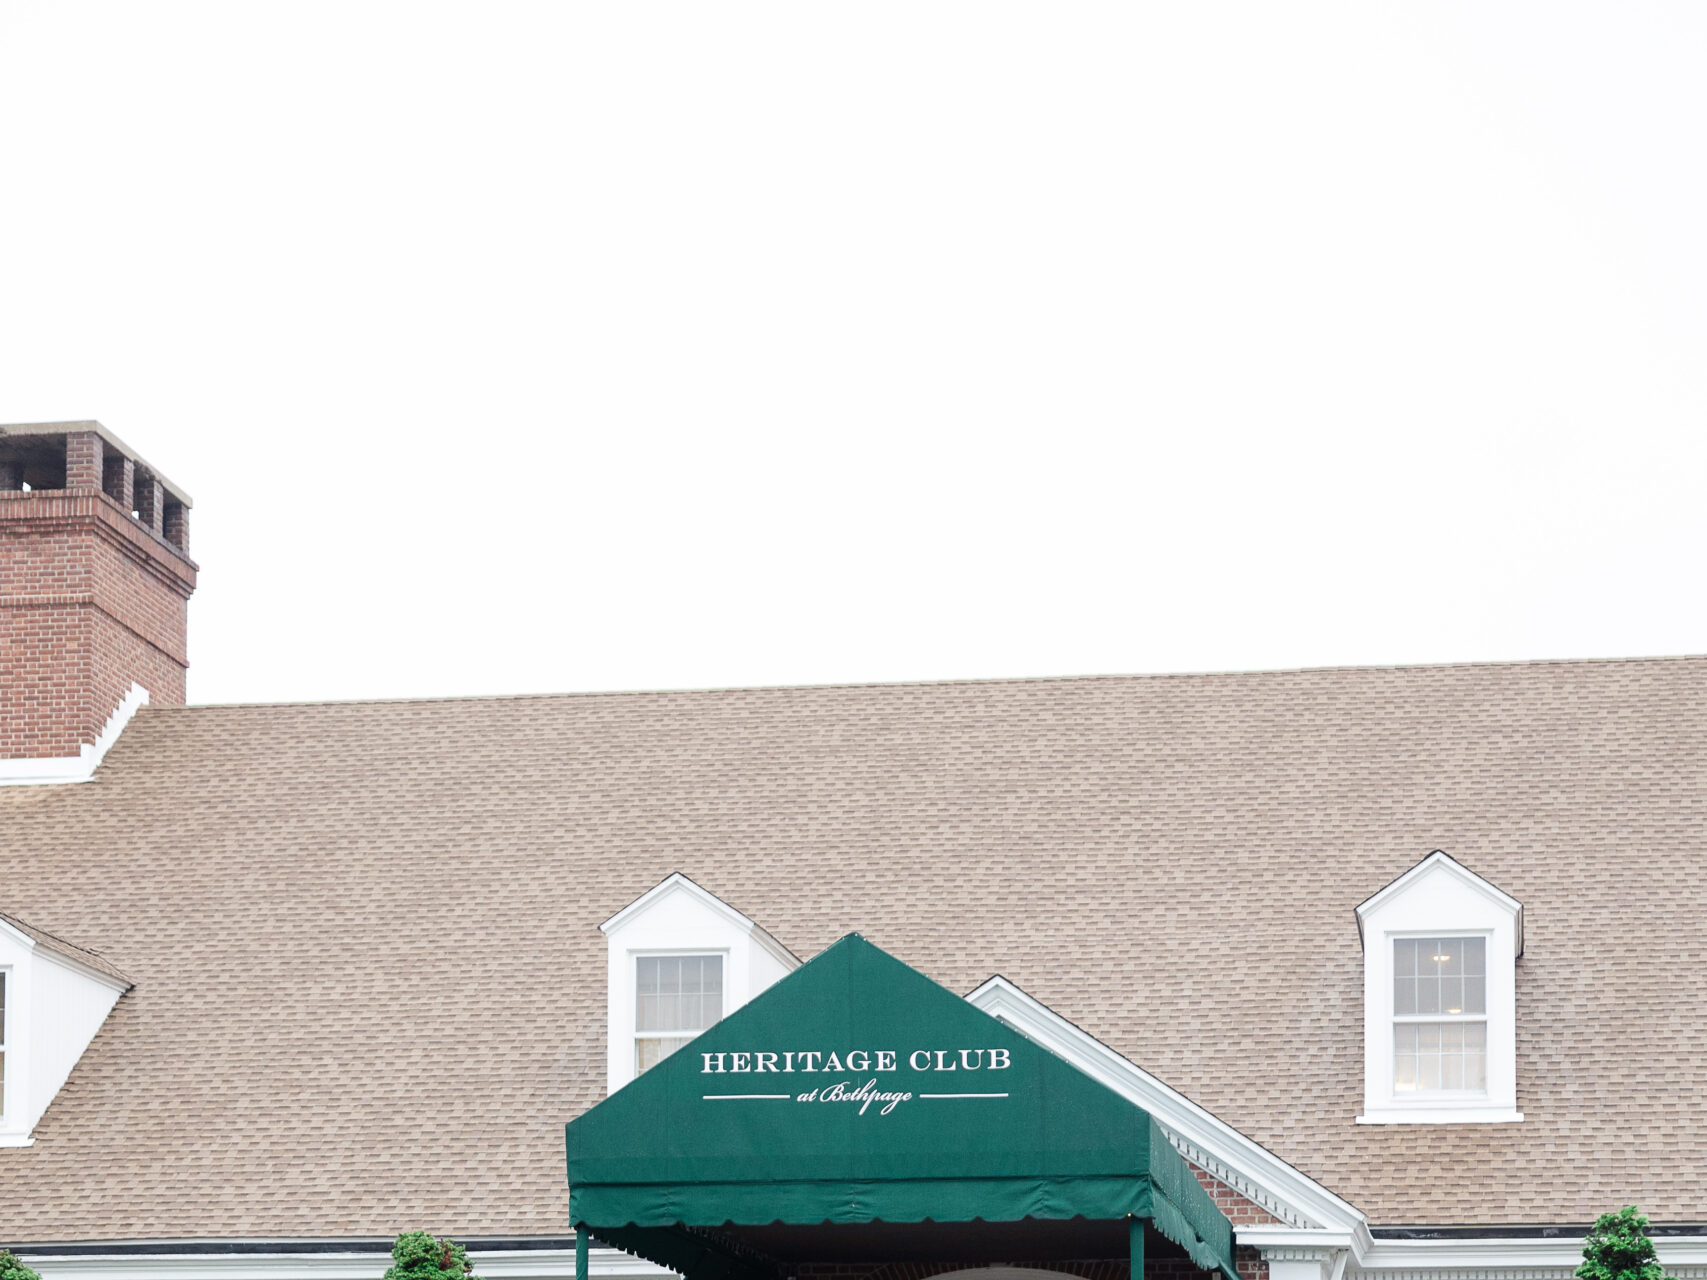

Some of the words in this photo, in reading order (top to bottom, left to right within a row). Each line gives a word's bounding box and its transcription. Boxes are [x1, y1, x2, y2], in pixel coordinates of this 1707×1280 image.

[700, 1050, 897, 1073] HERITAGE
[909, 1048, 1011, 1072] CLUB
[796, 1086, 818, 1103] at
[819, 1078, 913, 1116] Bethpage
